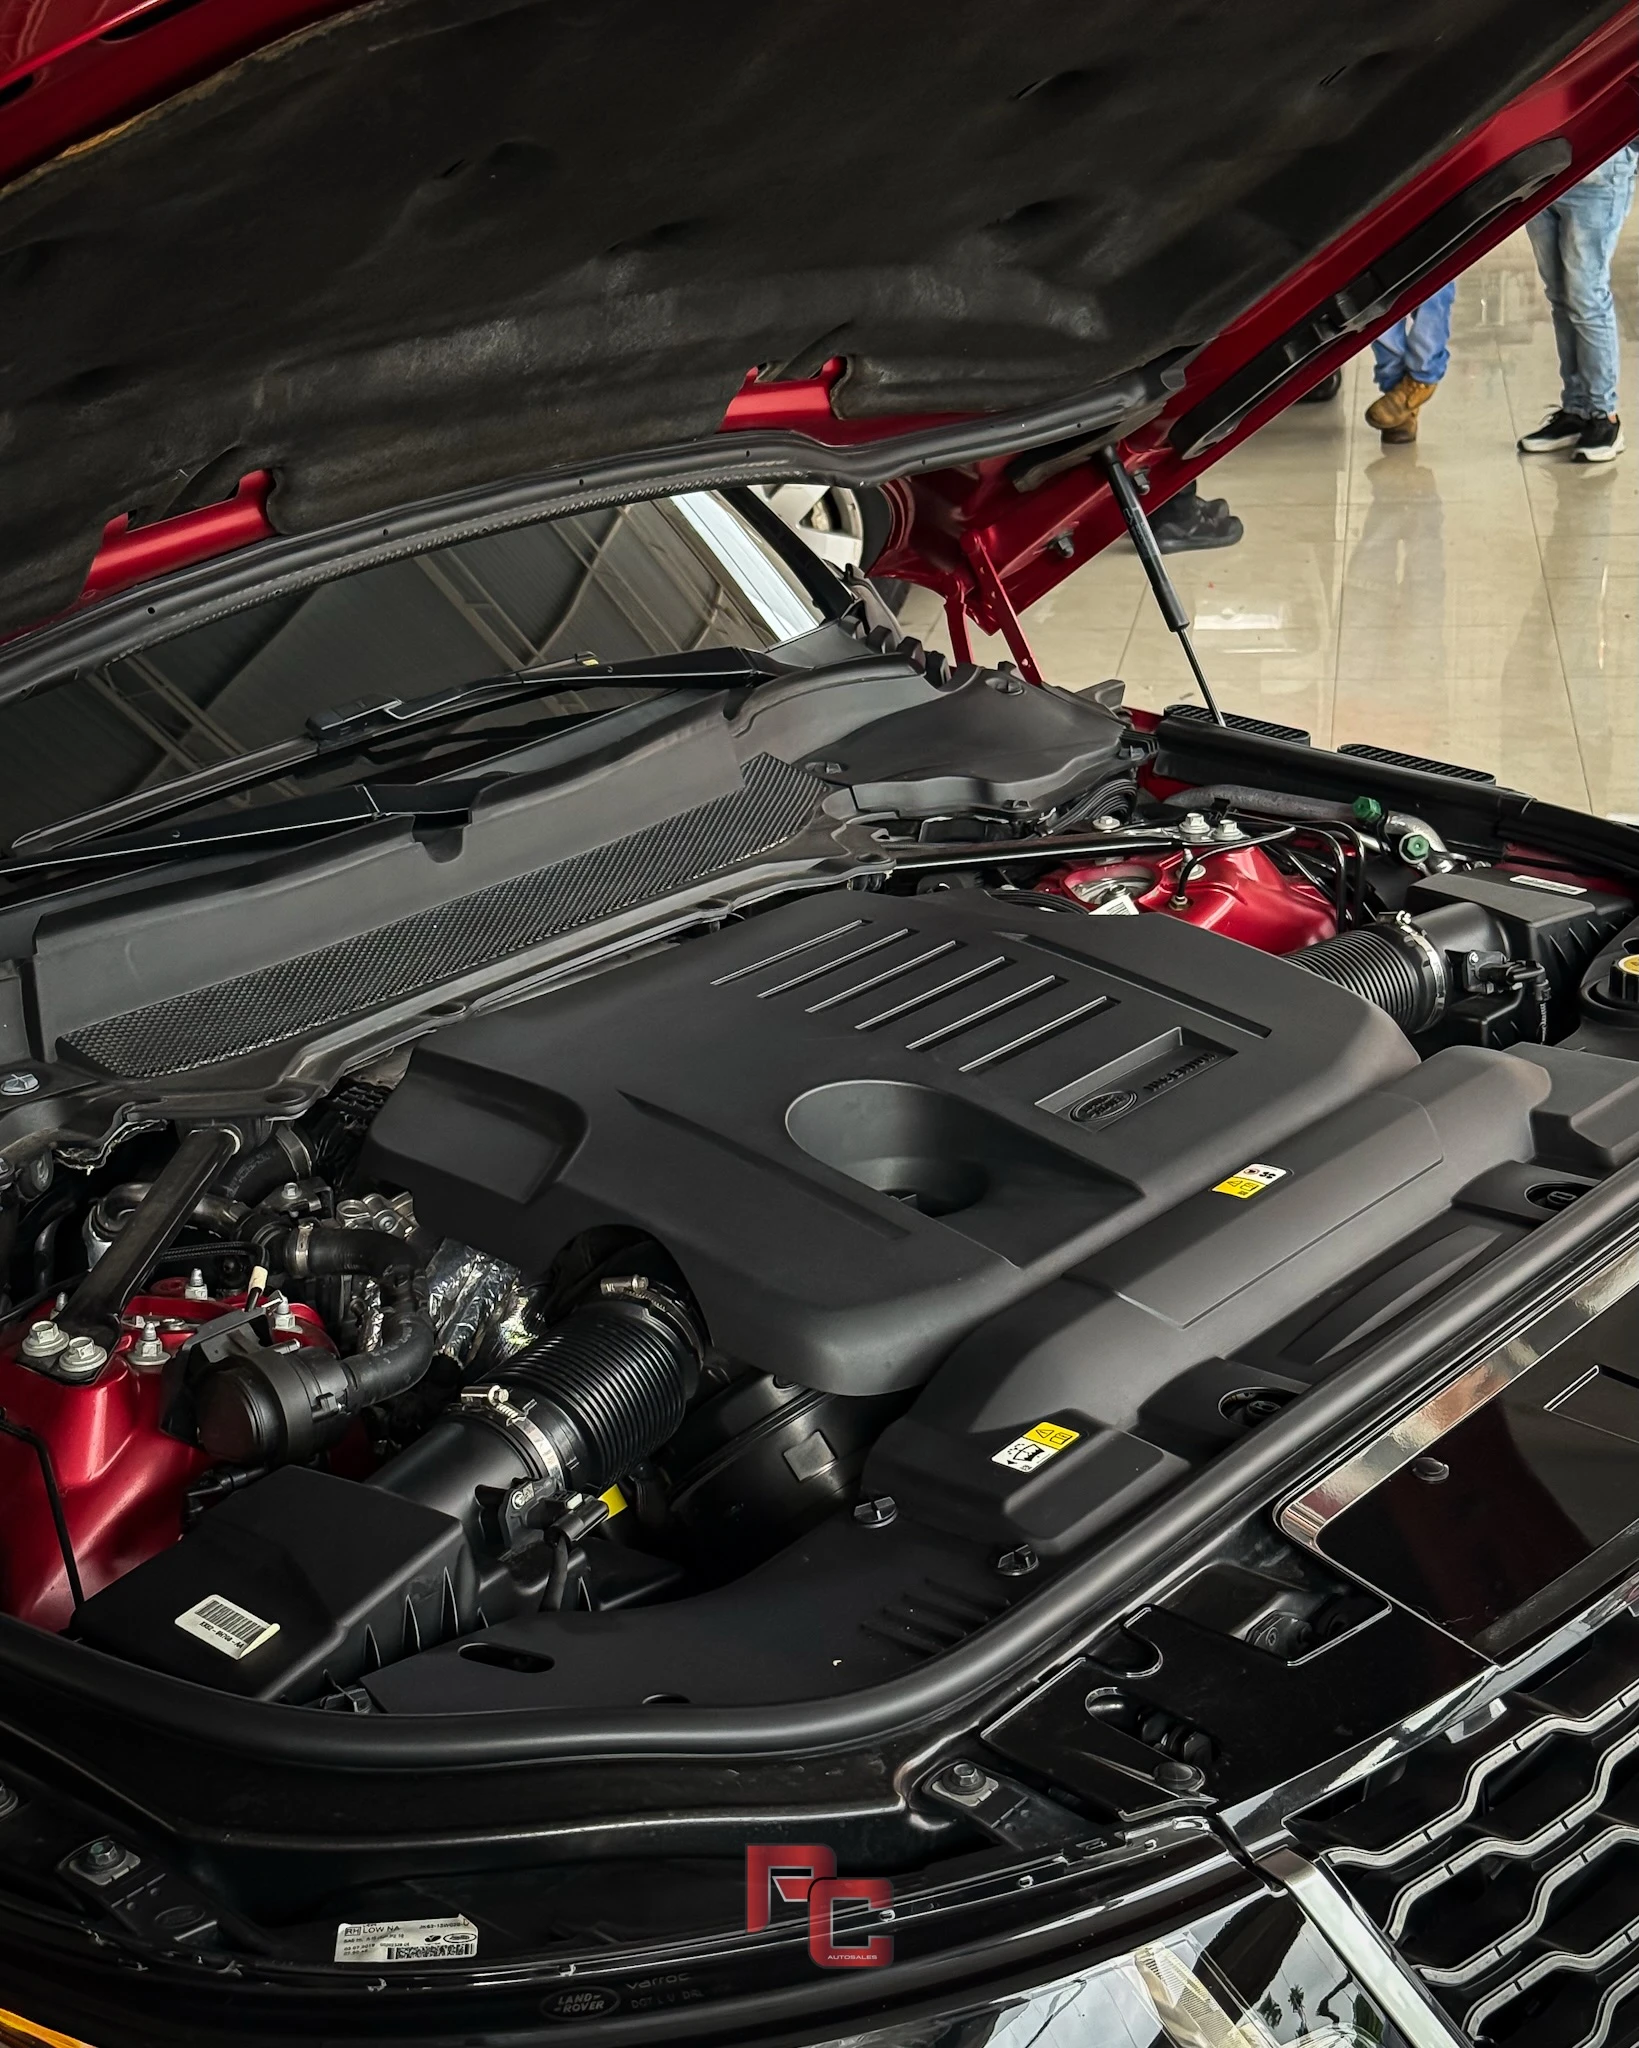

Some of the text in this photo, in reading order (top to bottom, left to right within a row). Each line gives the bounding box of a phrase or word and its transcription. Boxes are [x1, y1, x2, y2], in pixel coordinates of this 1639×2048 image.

[362, 1926, 385, 1934] LOW
[387, 1924, 401, 1933] NA
[626, 1973, 691, 1990] varroc
